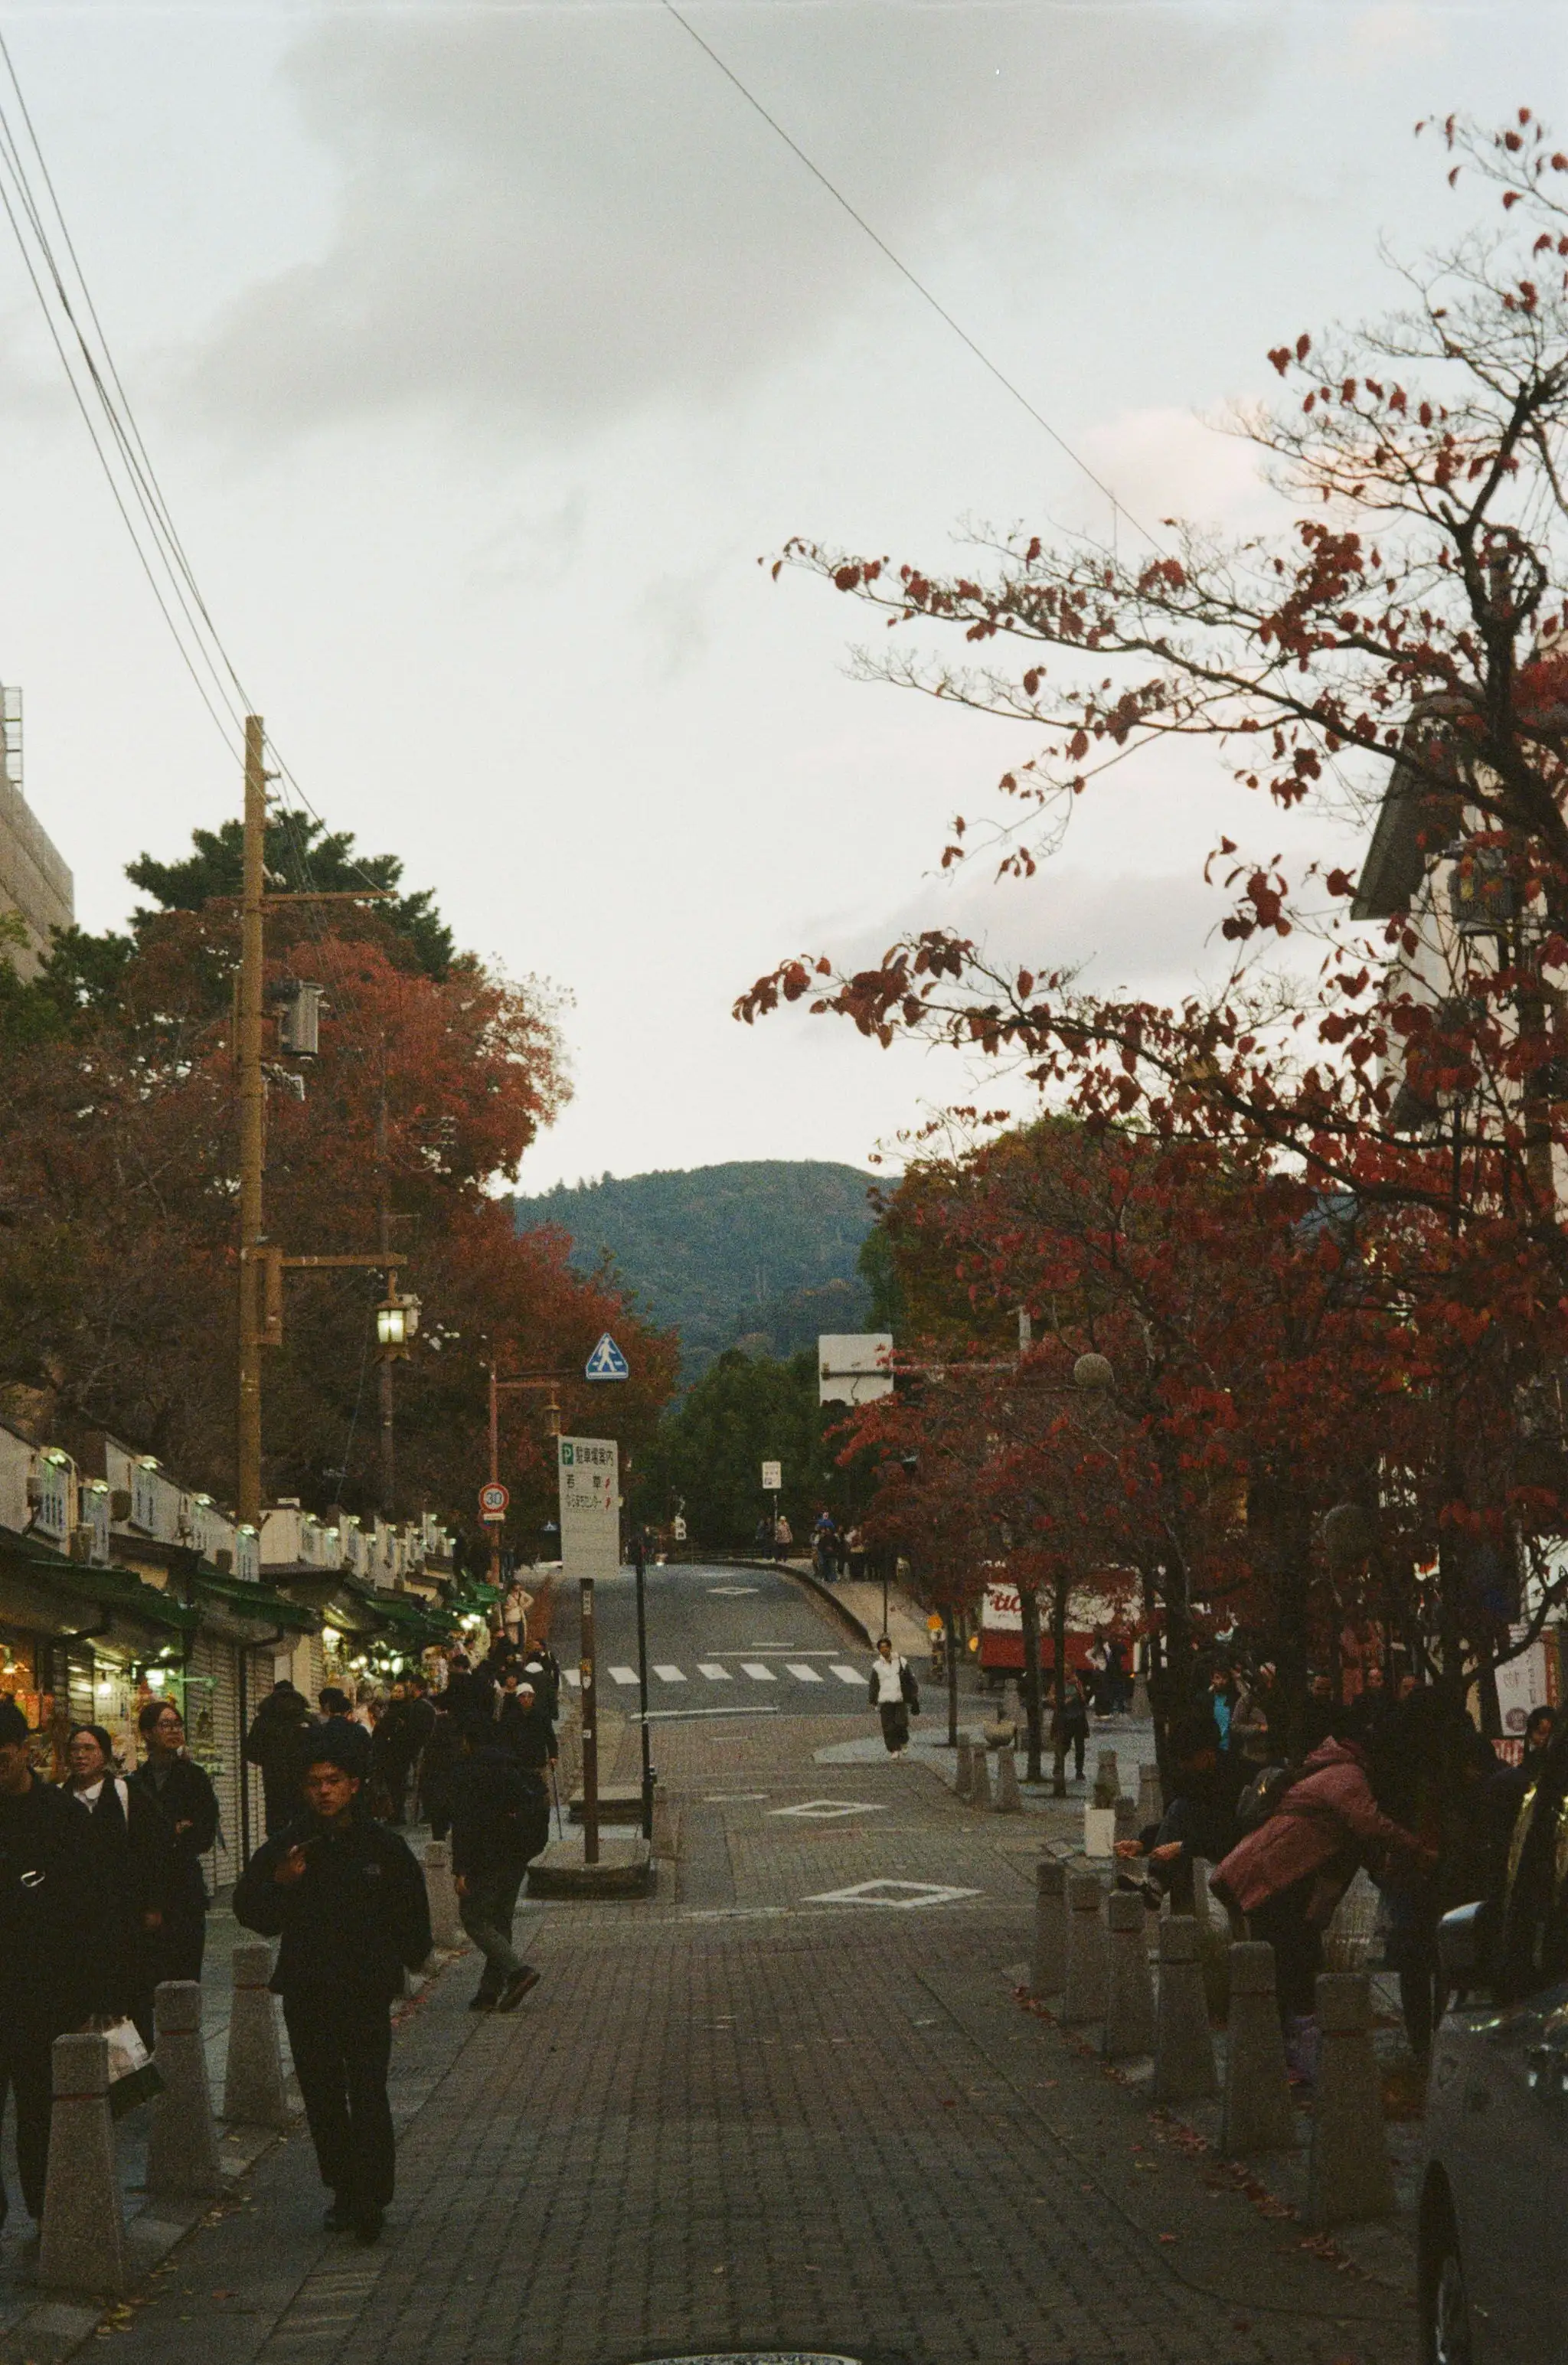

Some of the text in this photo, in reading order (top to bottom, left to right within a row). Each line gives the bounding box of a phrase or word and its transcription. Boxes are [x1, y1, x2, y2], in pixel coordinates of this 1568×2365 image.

[576, 1446, 613, 1466] 駐車場案内
[486, 1491, 502, 1505] 30
